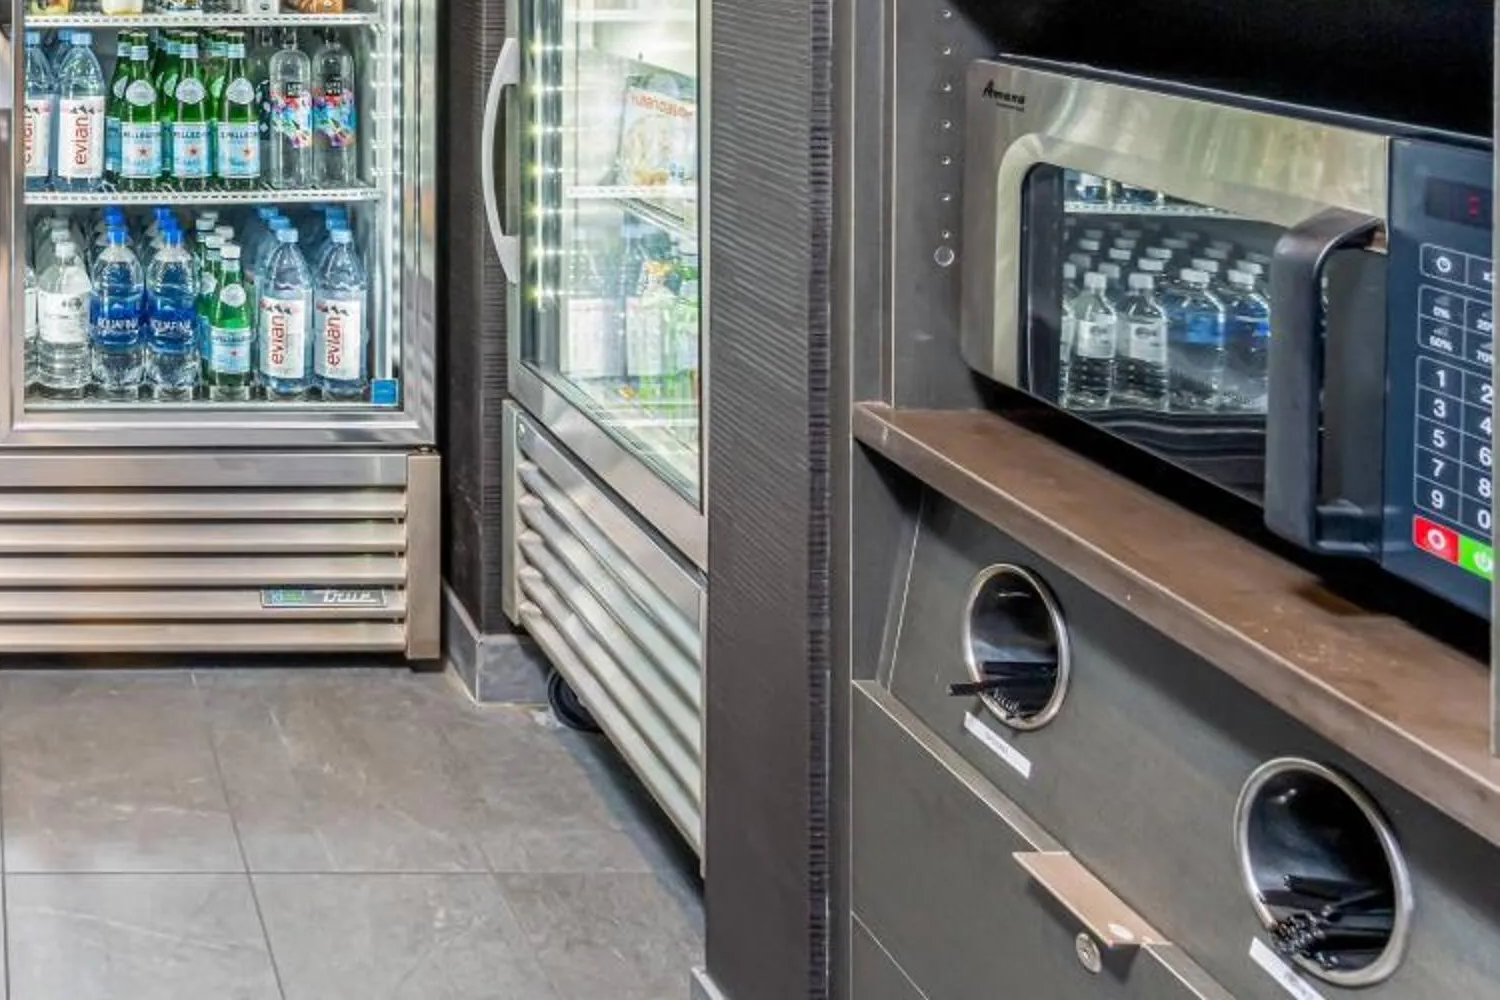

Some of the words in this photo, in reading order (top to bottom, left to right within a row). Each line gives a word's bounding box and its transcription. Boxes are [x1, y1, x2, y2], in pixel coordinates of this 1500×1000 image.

[75, 115, 89, 165] evian
[271, 315, 285, 365] evian
[327, 316, 342, 367] evian
[1436, 369, 1446, 388] 1
[1480, 384, 1493, 405] 2
[1433, 399, 1446, 418] 3
[1479, 416, 1492, 435] 4
[1432, 429, 1446, 448] 5
[1478, 447, 1492, 466] 6
[1431, 459, 1445, 477] 7
[1477, 478, 1491, 498] 8
[1430, 489, 1444, 509] 9
[1477, 509, 1491, 529] 0
